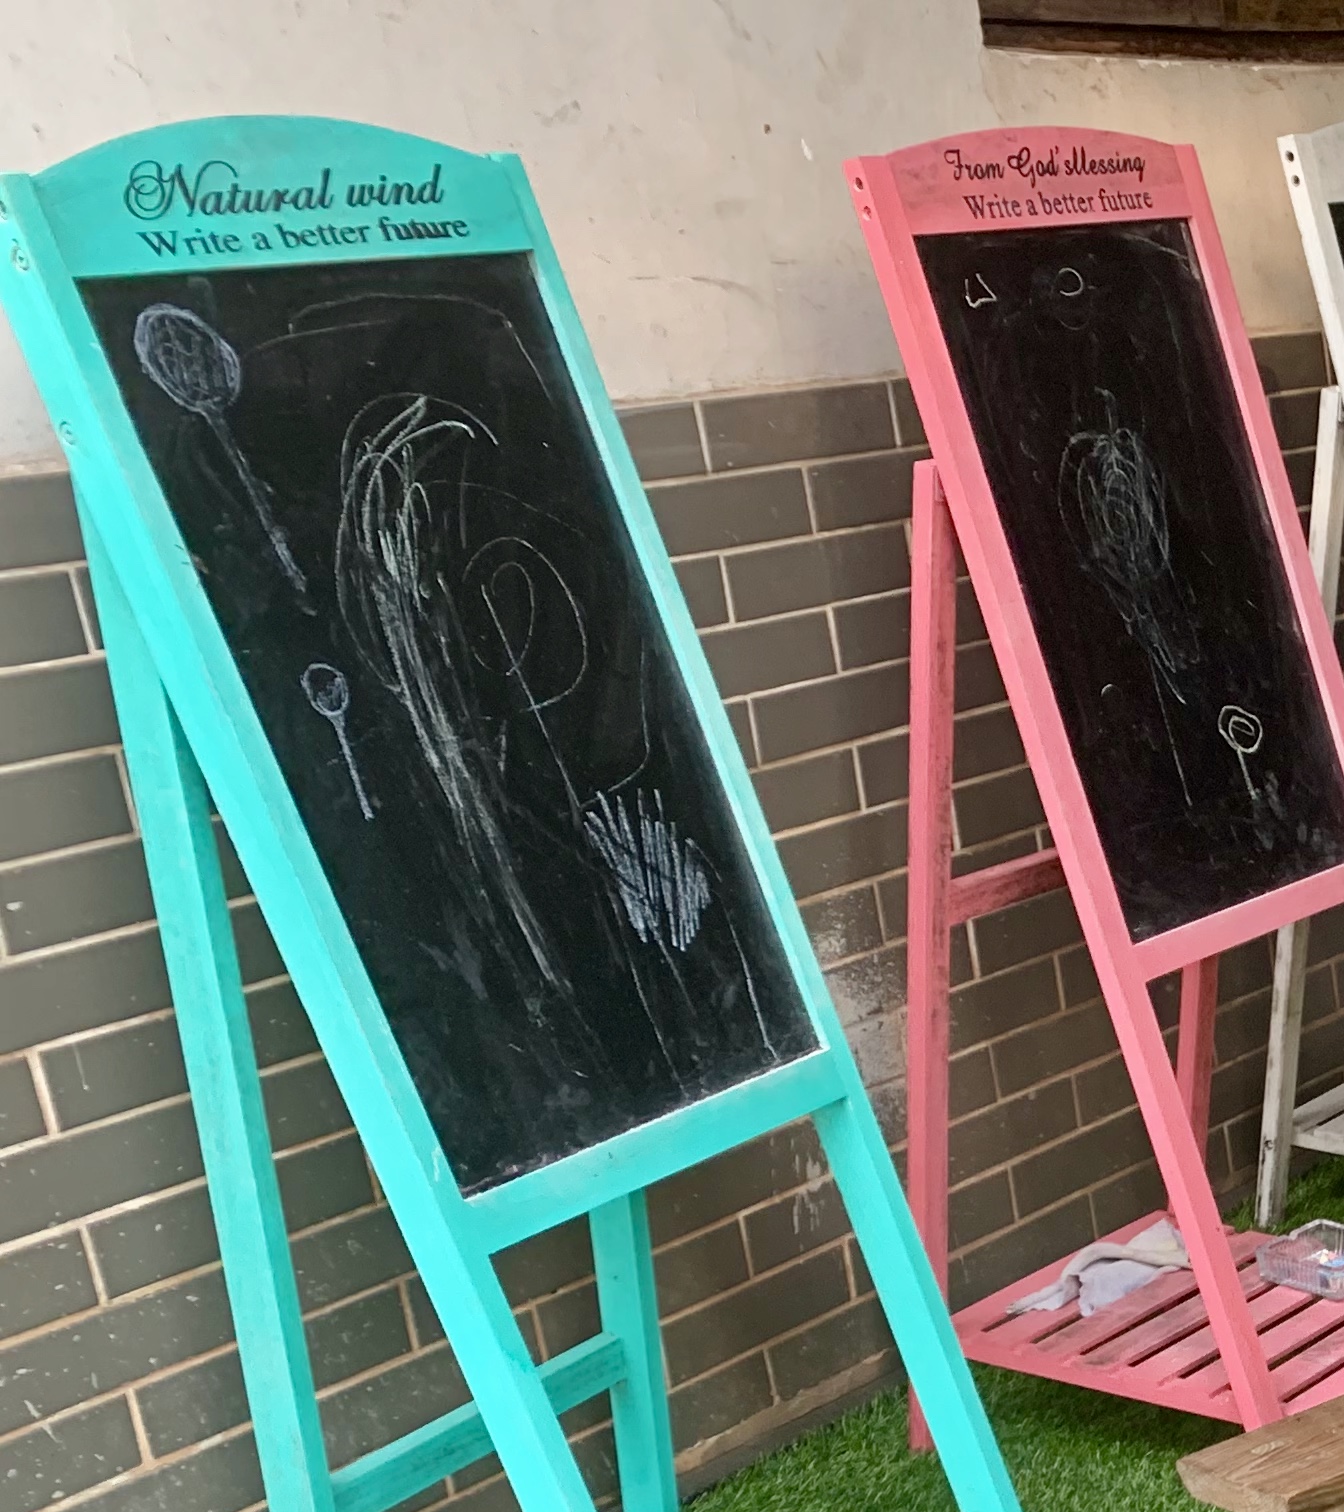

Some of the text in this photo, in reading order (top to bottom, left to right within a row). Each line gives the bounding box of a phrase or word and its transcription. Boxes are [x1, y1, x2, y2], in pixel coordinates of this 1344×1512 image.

[944, 149, 1005, 181] From
[123, 159, 446, 221] Natural wind
[962, 188, 1154, 220] Write a better future
[137, 216, 471, 257] Write a better future
